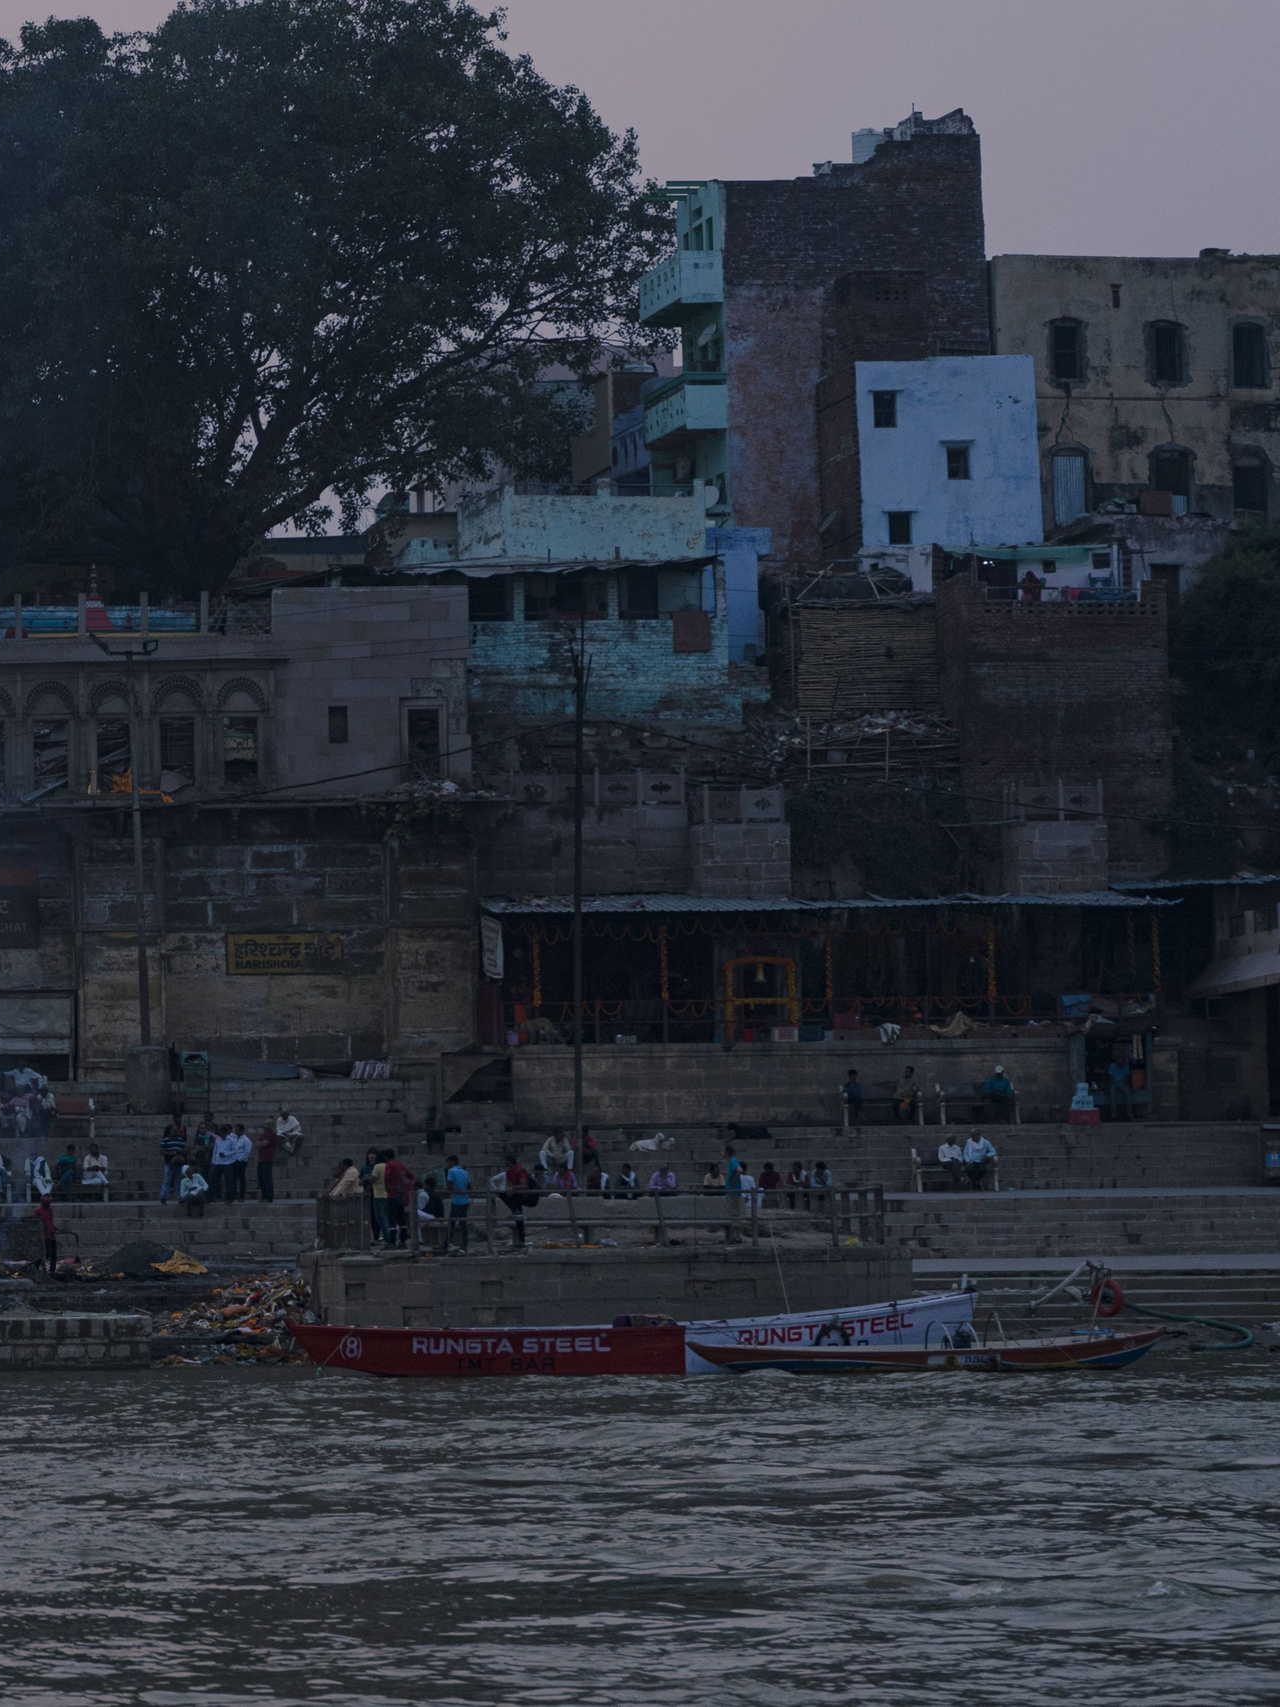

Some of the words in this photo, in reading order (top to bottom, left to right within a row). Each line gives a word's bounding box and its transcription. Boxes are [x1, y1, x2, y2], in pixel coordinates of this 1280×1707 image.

[841, 1314, 913, 1337] STEEL
[412, 1337, 514, 1354] RUNGTA
[521, 1335, 612, 1353] STEEL
[457, 1357, 497, 1371] TMT
[510, 1357, 556, 1371] BAR
